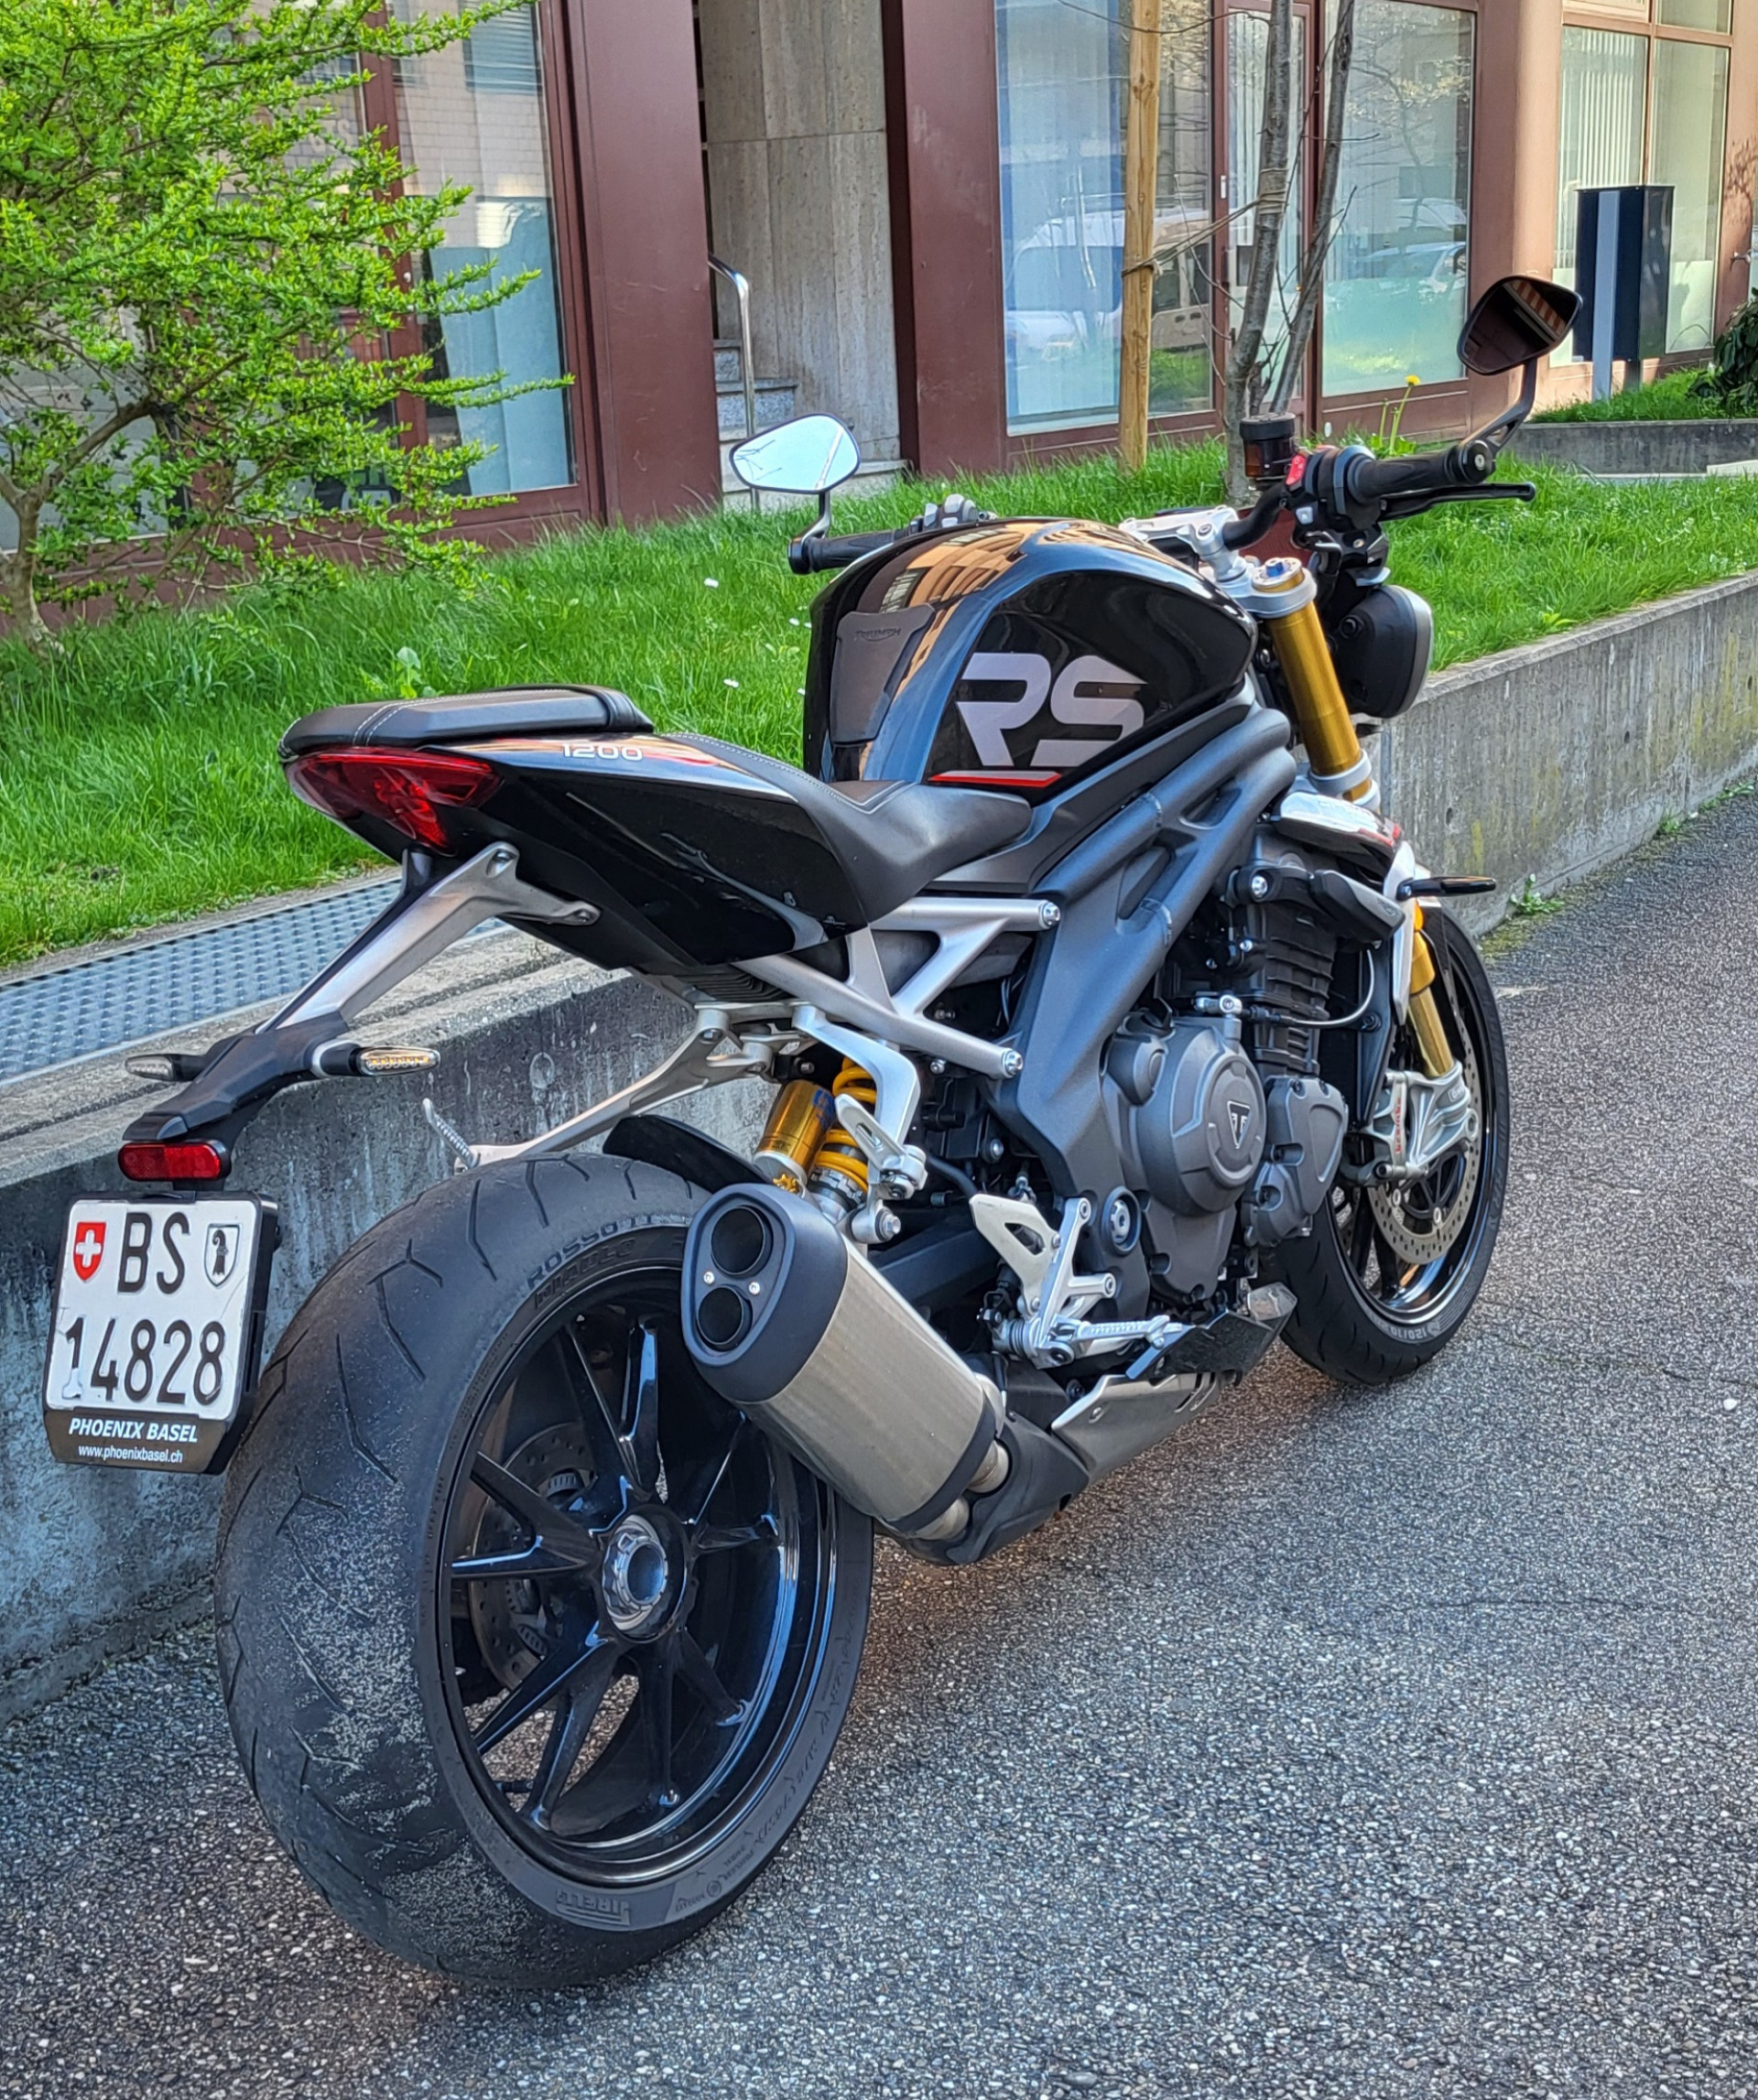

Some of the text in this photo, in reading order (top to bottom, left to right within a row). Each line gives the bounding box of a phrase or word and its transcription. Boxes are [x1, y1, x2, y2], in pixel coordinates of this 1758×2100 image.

[956, 652, 1148, 767] RS
[562, 742, 643, 762] 1200
[118, 1211, 190, 1294] BS
[526, 1220, 619, 1290] ROSSO
[61, 1317, 225, 1406] 14828
[68, 1417, 198, 1443] PHOENIX BASEL
[78, 1445, 183, 1464] www.phoenixbasel.ch
